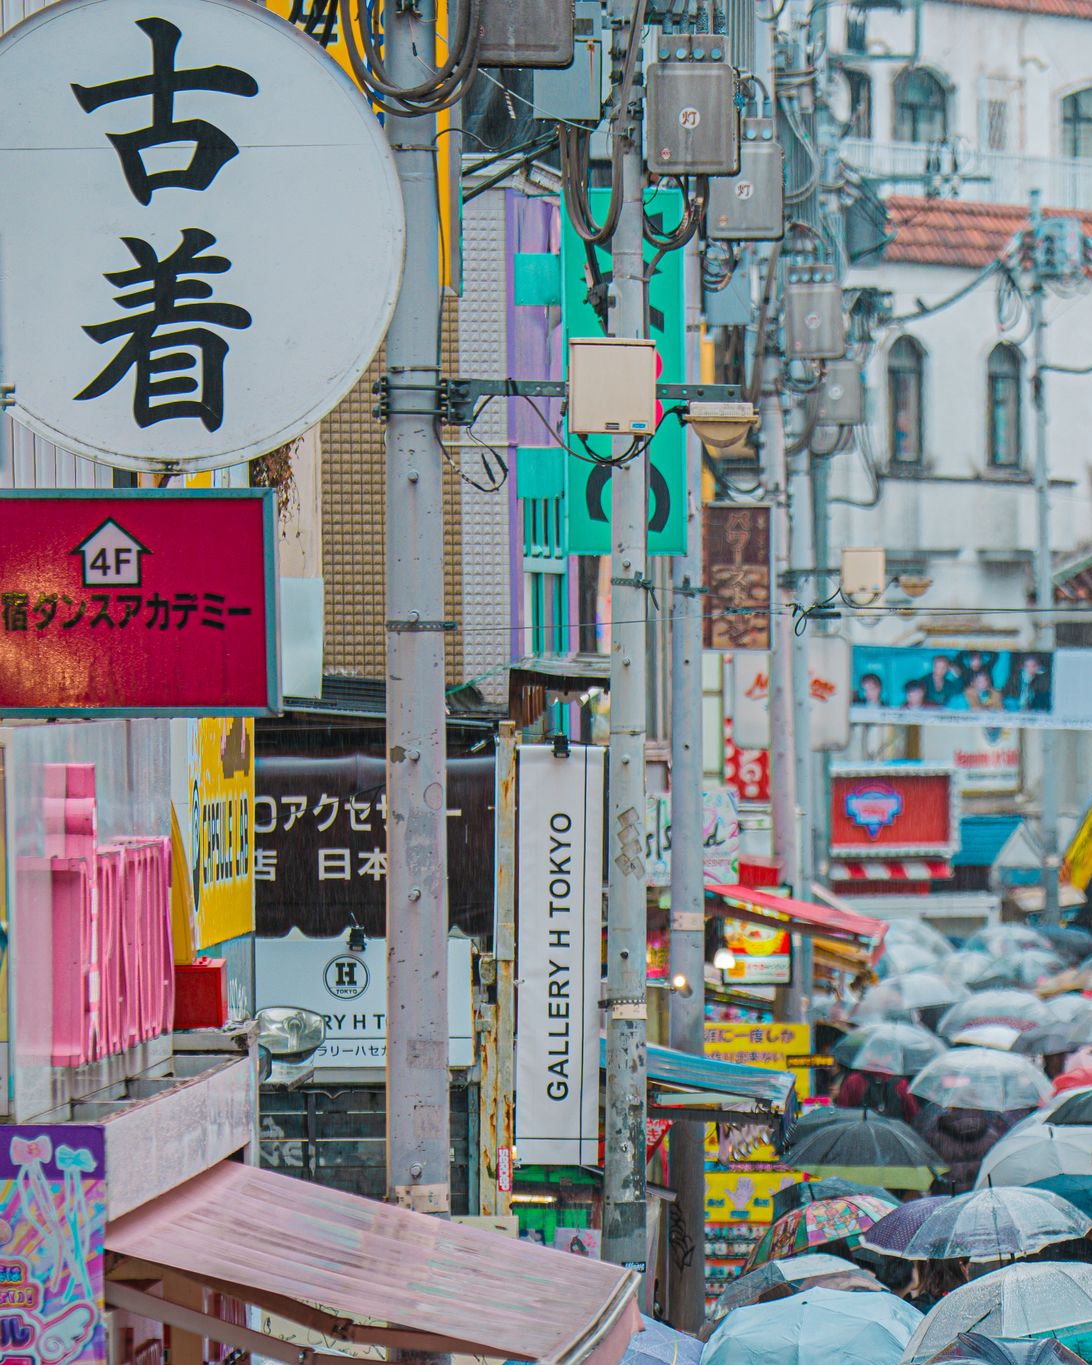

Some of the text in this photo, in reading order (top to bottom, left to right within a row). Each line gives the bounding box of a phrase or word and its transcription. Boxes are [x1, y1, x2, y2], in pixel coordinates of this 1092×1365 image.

[681, 110, 697, 126] 灯
[70, 16, 260, 434] 古着
[90, 548, 132, 576] 4F
[0, 592, 252, 631] 宿ダンスアカデミー
[547, 812, 572, 1102] GALLERY H TOKYO
[353, 1014, 367, 1030] H
